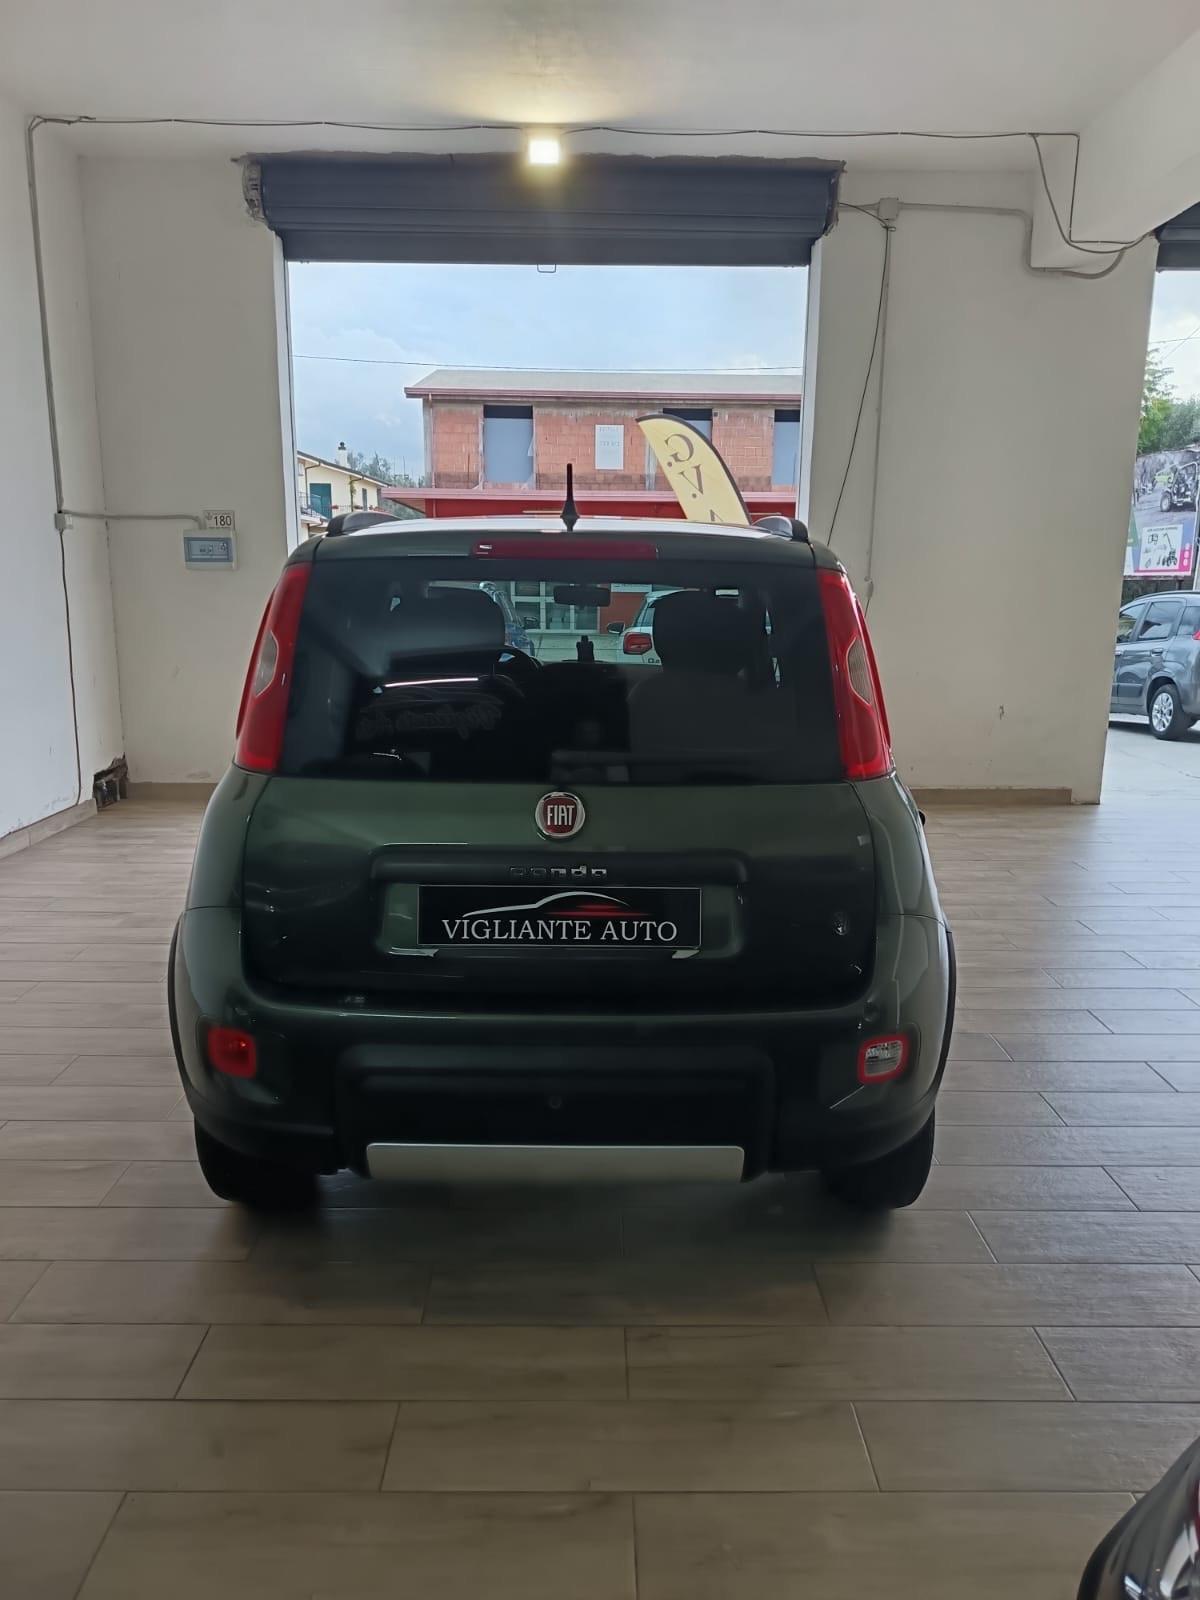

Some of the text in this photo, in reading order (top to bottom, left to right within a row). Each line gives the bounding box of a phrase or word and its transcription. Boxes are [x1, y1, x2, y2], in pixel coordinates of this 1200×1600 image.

[214, 515, 232, 526] 180
[546, 804, 575, 826] FIAT
[441, 919, 678, 942] VIGLIANTE AUTO
